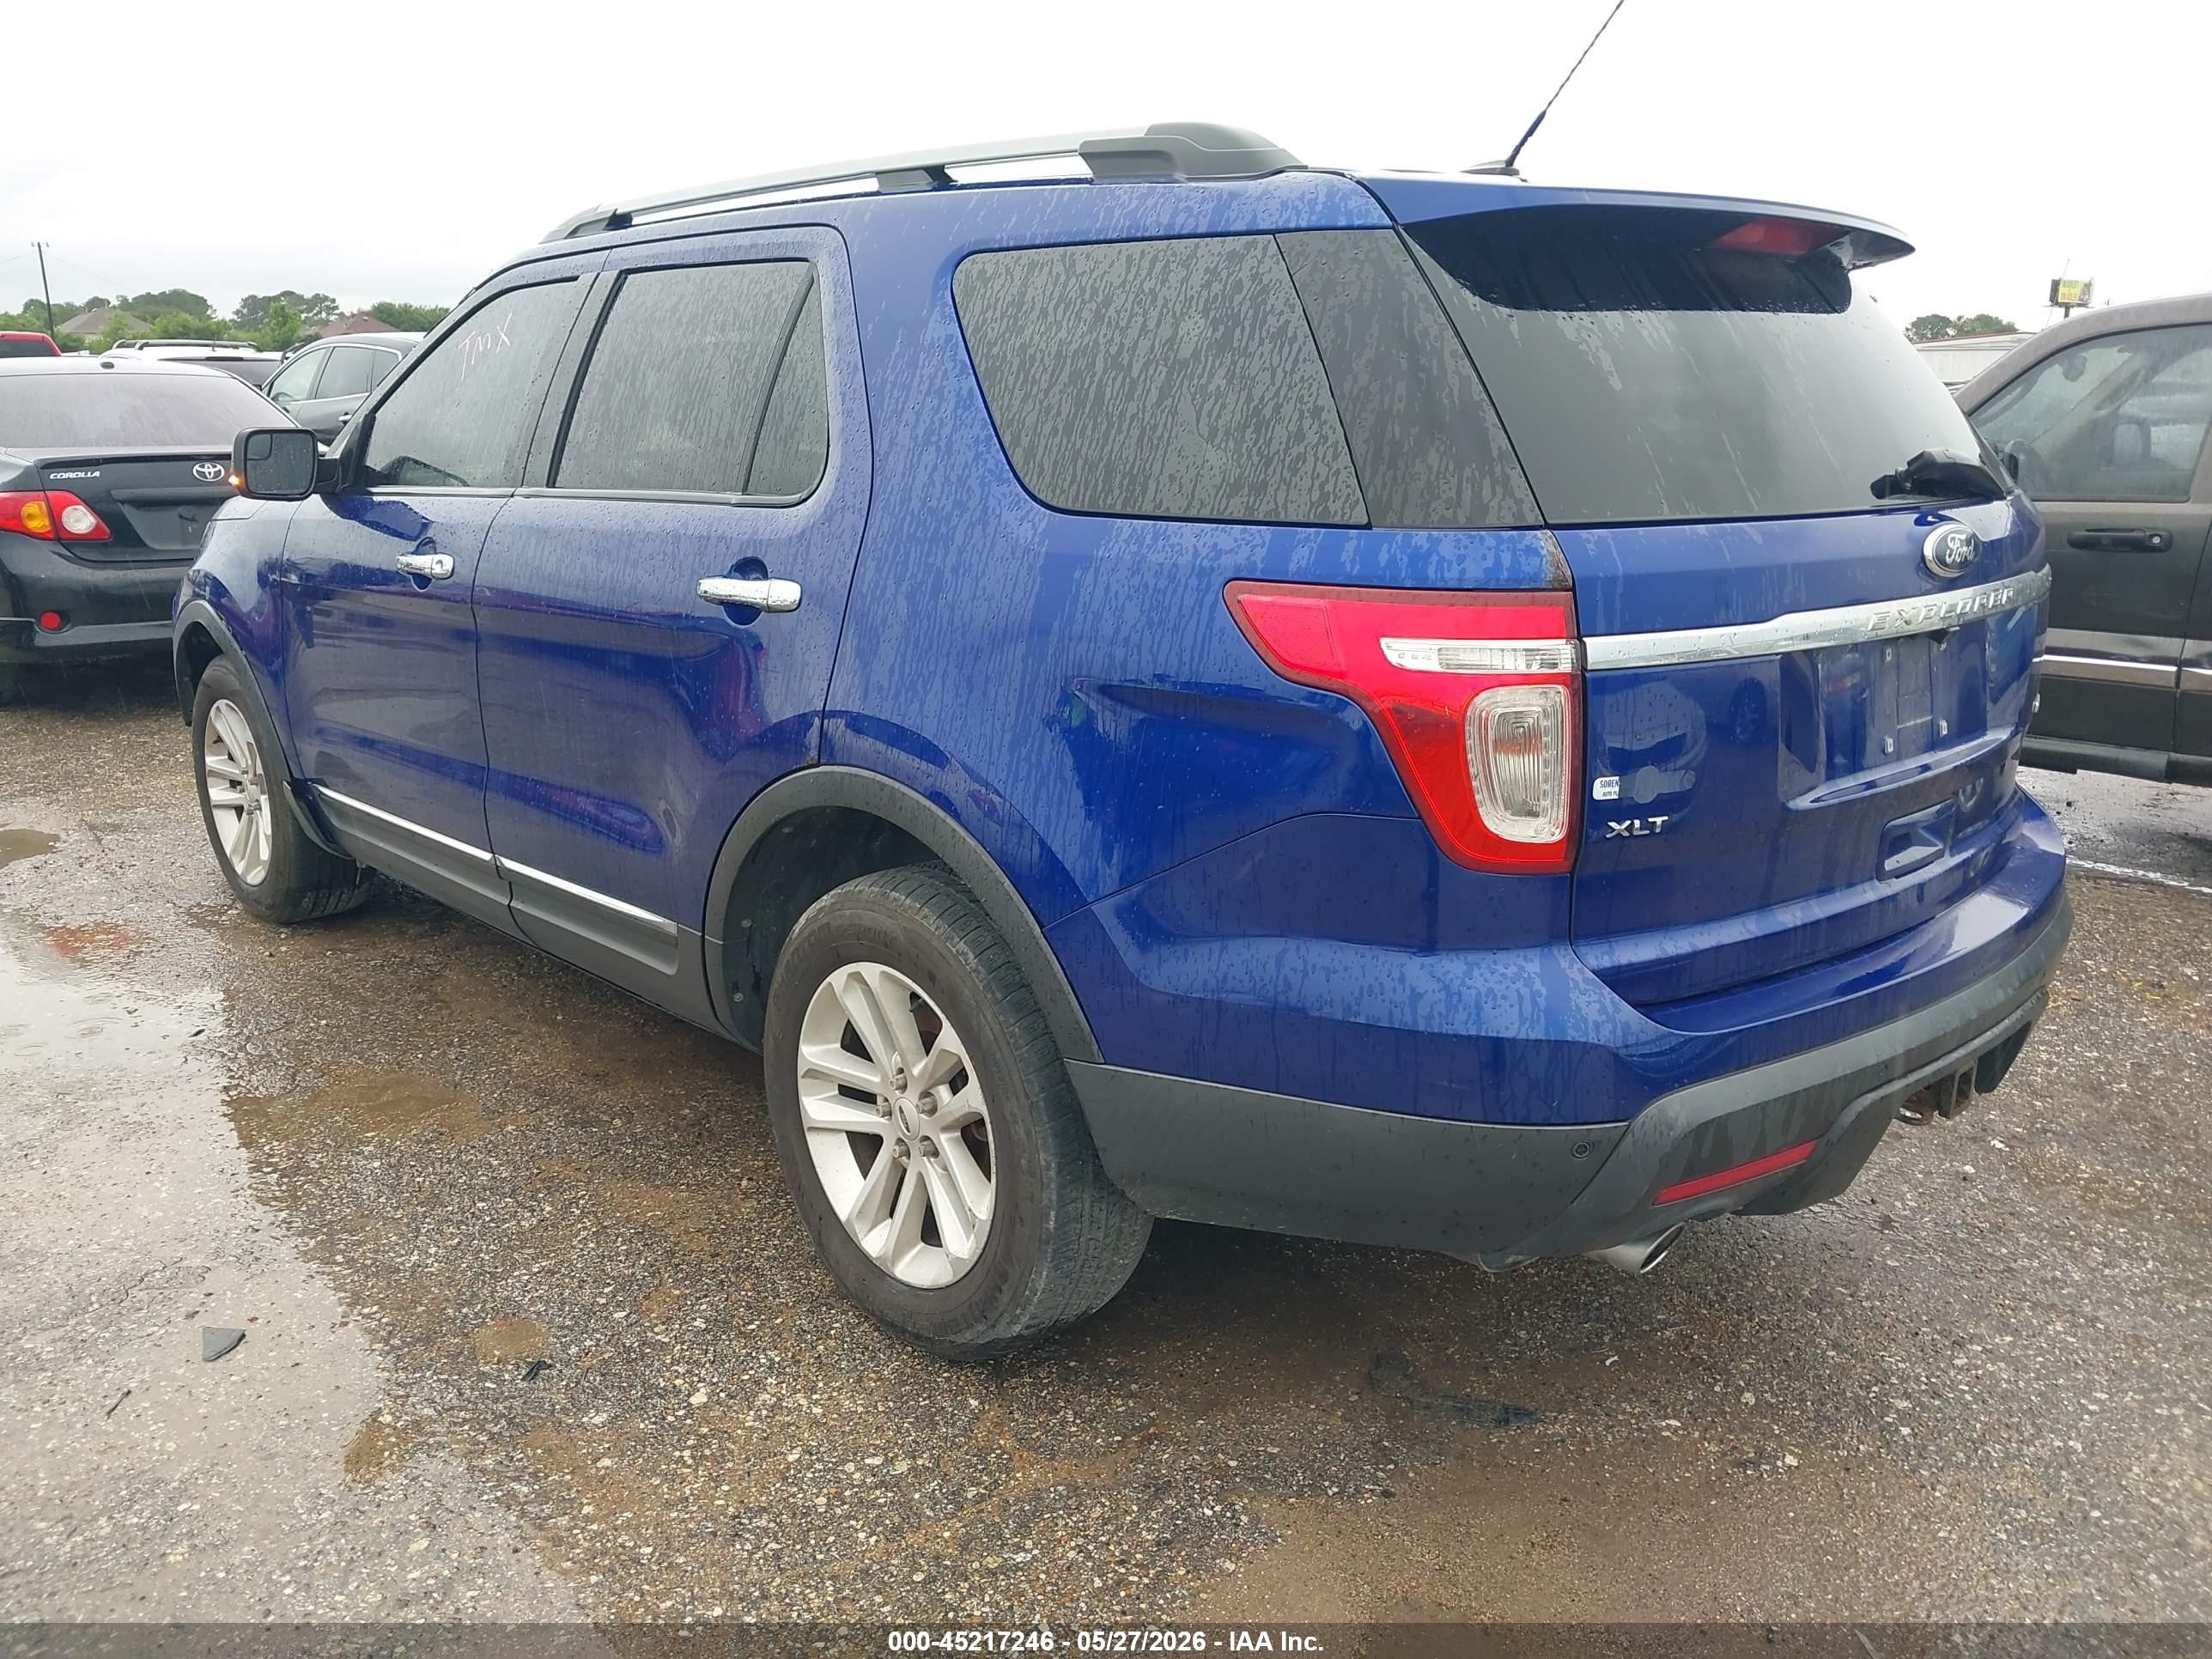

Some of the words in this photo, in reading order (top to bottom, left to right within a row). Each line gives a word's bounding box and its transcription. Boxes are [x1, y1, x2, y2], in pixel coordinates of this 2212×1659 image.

[50, 471, 100, 479] COROLLA
[1946, 533, 1976, 564] Ford
[1866, 587, 2014, 632] EXPLORER
[1606, 816, 1668, 838] XLT
